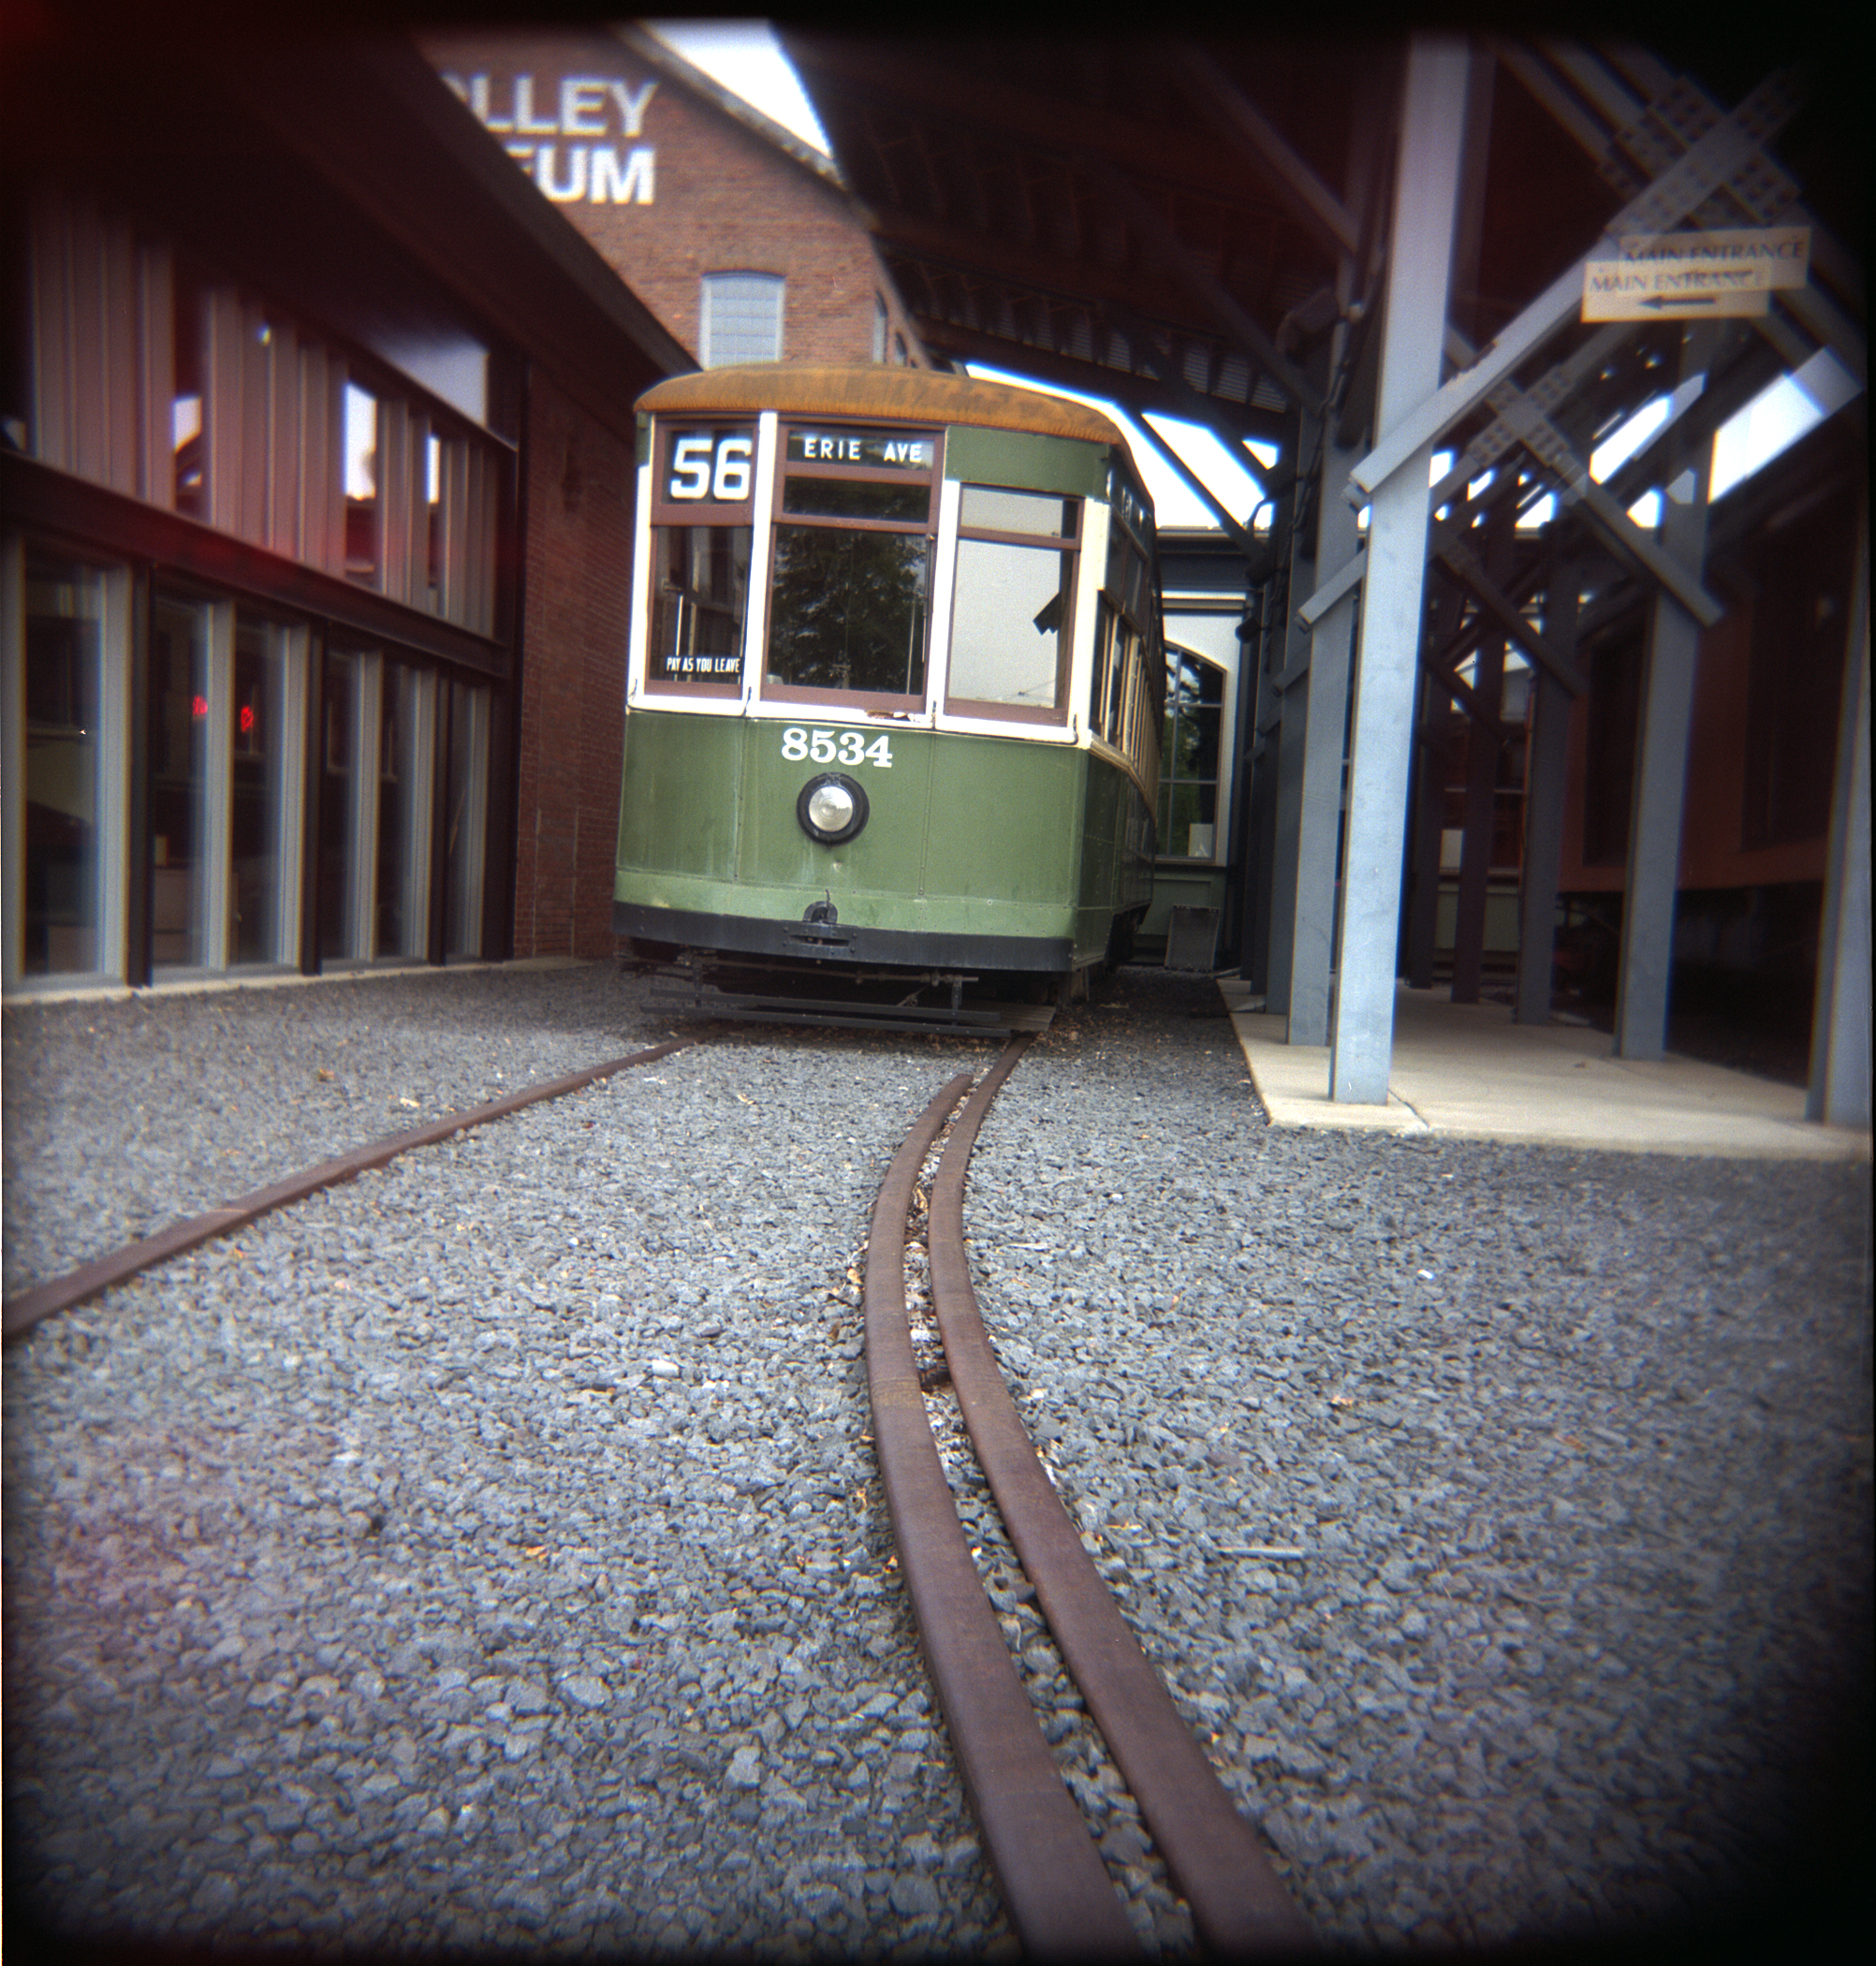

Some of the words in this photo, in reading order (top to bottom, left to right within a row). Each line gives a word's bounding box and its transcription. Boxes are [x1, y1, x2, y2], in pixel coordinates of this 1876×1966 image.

[441, 73, 658, 138] LLEY
[504, 145, 654, 205] UM
[1689, 241, 1804, 260] ENTRANCE
[1590, 273, 1647, 293] MAIN
[803, 436, 861, 461] ERIE
[884, 442, 923, 462] AVE
[670, 438, 753, 501] 56
[667, 657, 682, 671] PAY
[682, 657, 694, 672] AS
[696, 657, 712, 672] YOU
[714, 658, 740, 673] LEAVE
[781, 727, 893, 768] 8534
